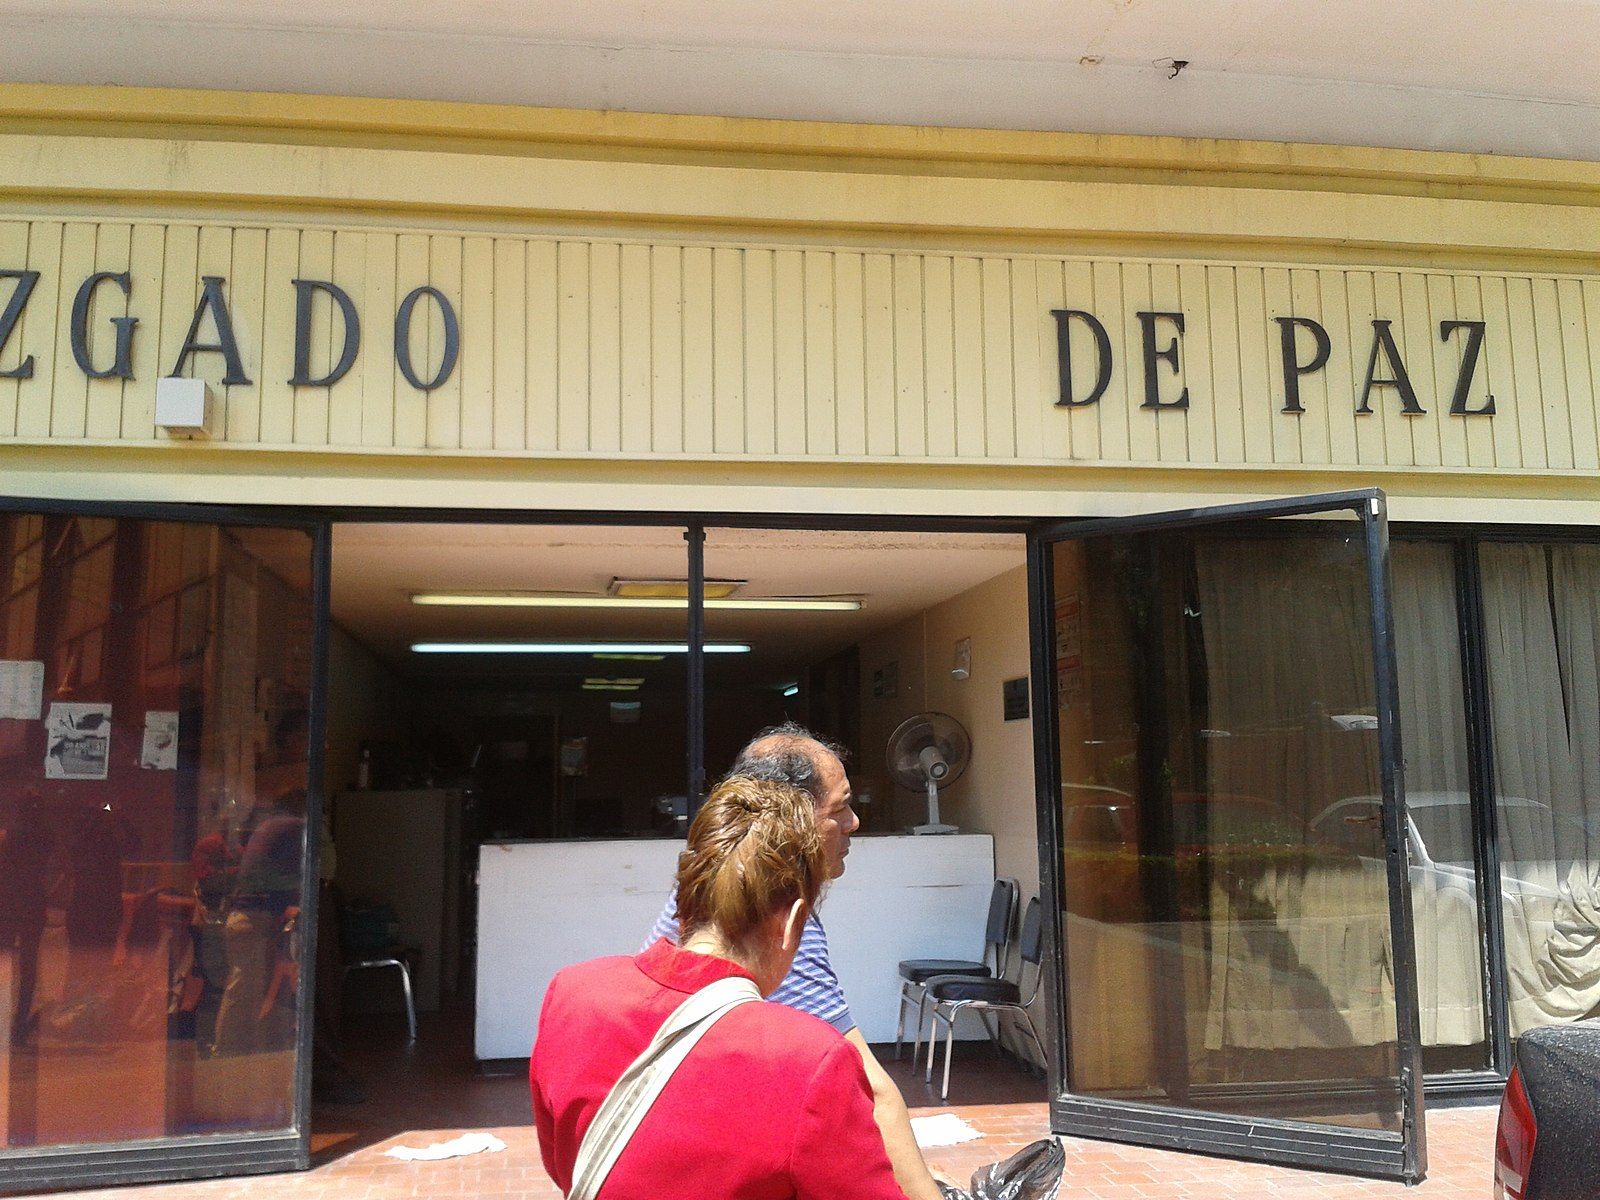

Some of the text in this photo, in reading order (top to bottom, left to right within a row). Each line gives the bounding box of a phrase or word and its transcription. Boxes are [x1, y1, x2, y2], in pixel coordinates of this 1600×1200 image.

[0, 269, 1497, 416] ZGADO DE PAZ
